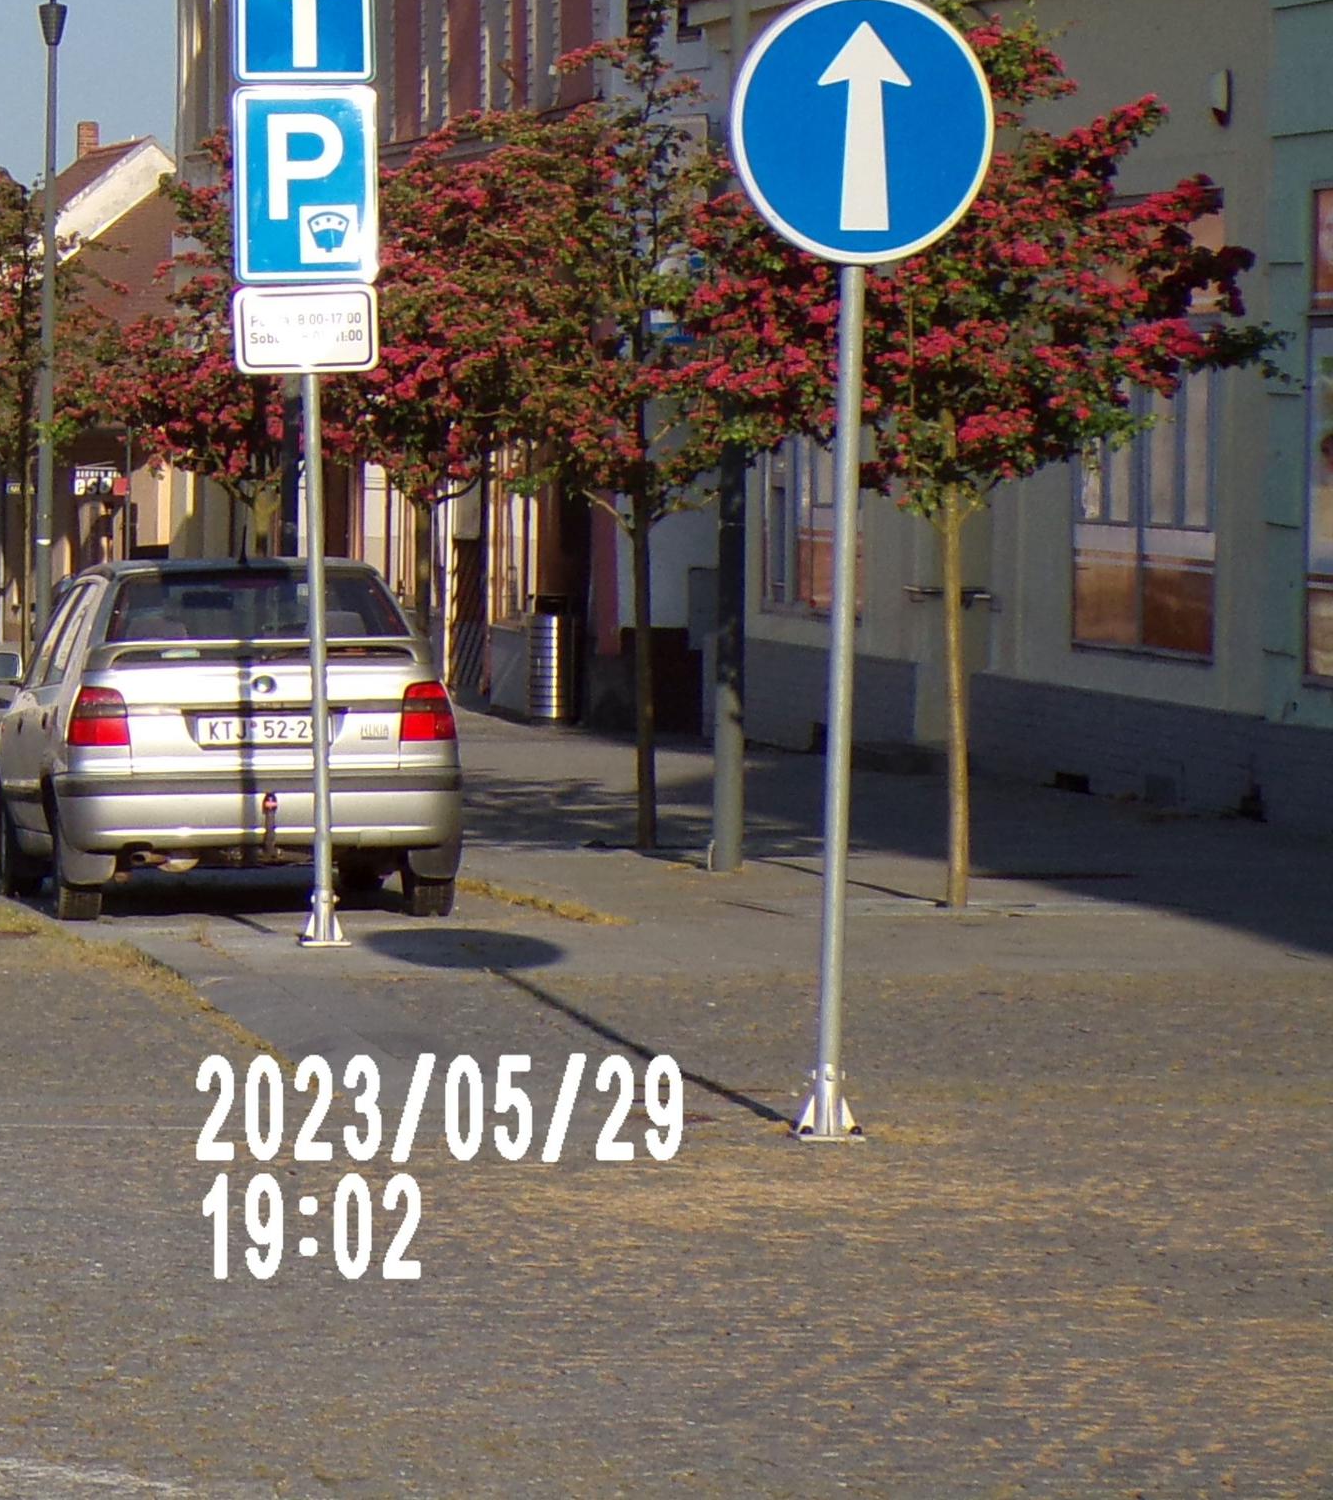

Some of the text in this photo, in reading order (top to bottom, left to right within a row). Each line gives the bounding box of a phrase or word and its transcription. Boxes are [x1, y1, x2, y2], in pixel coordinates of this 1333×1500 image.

[267, 113, 344, 220] P
[297, 312, 362, 326] 800-1700
[208, 720, 314, 740] KTJ 52-2
